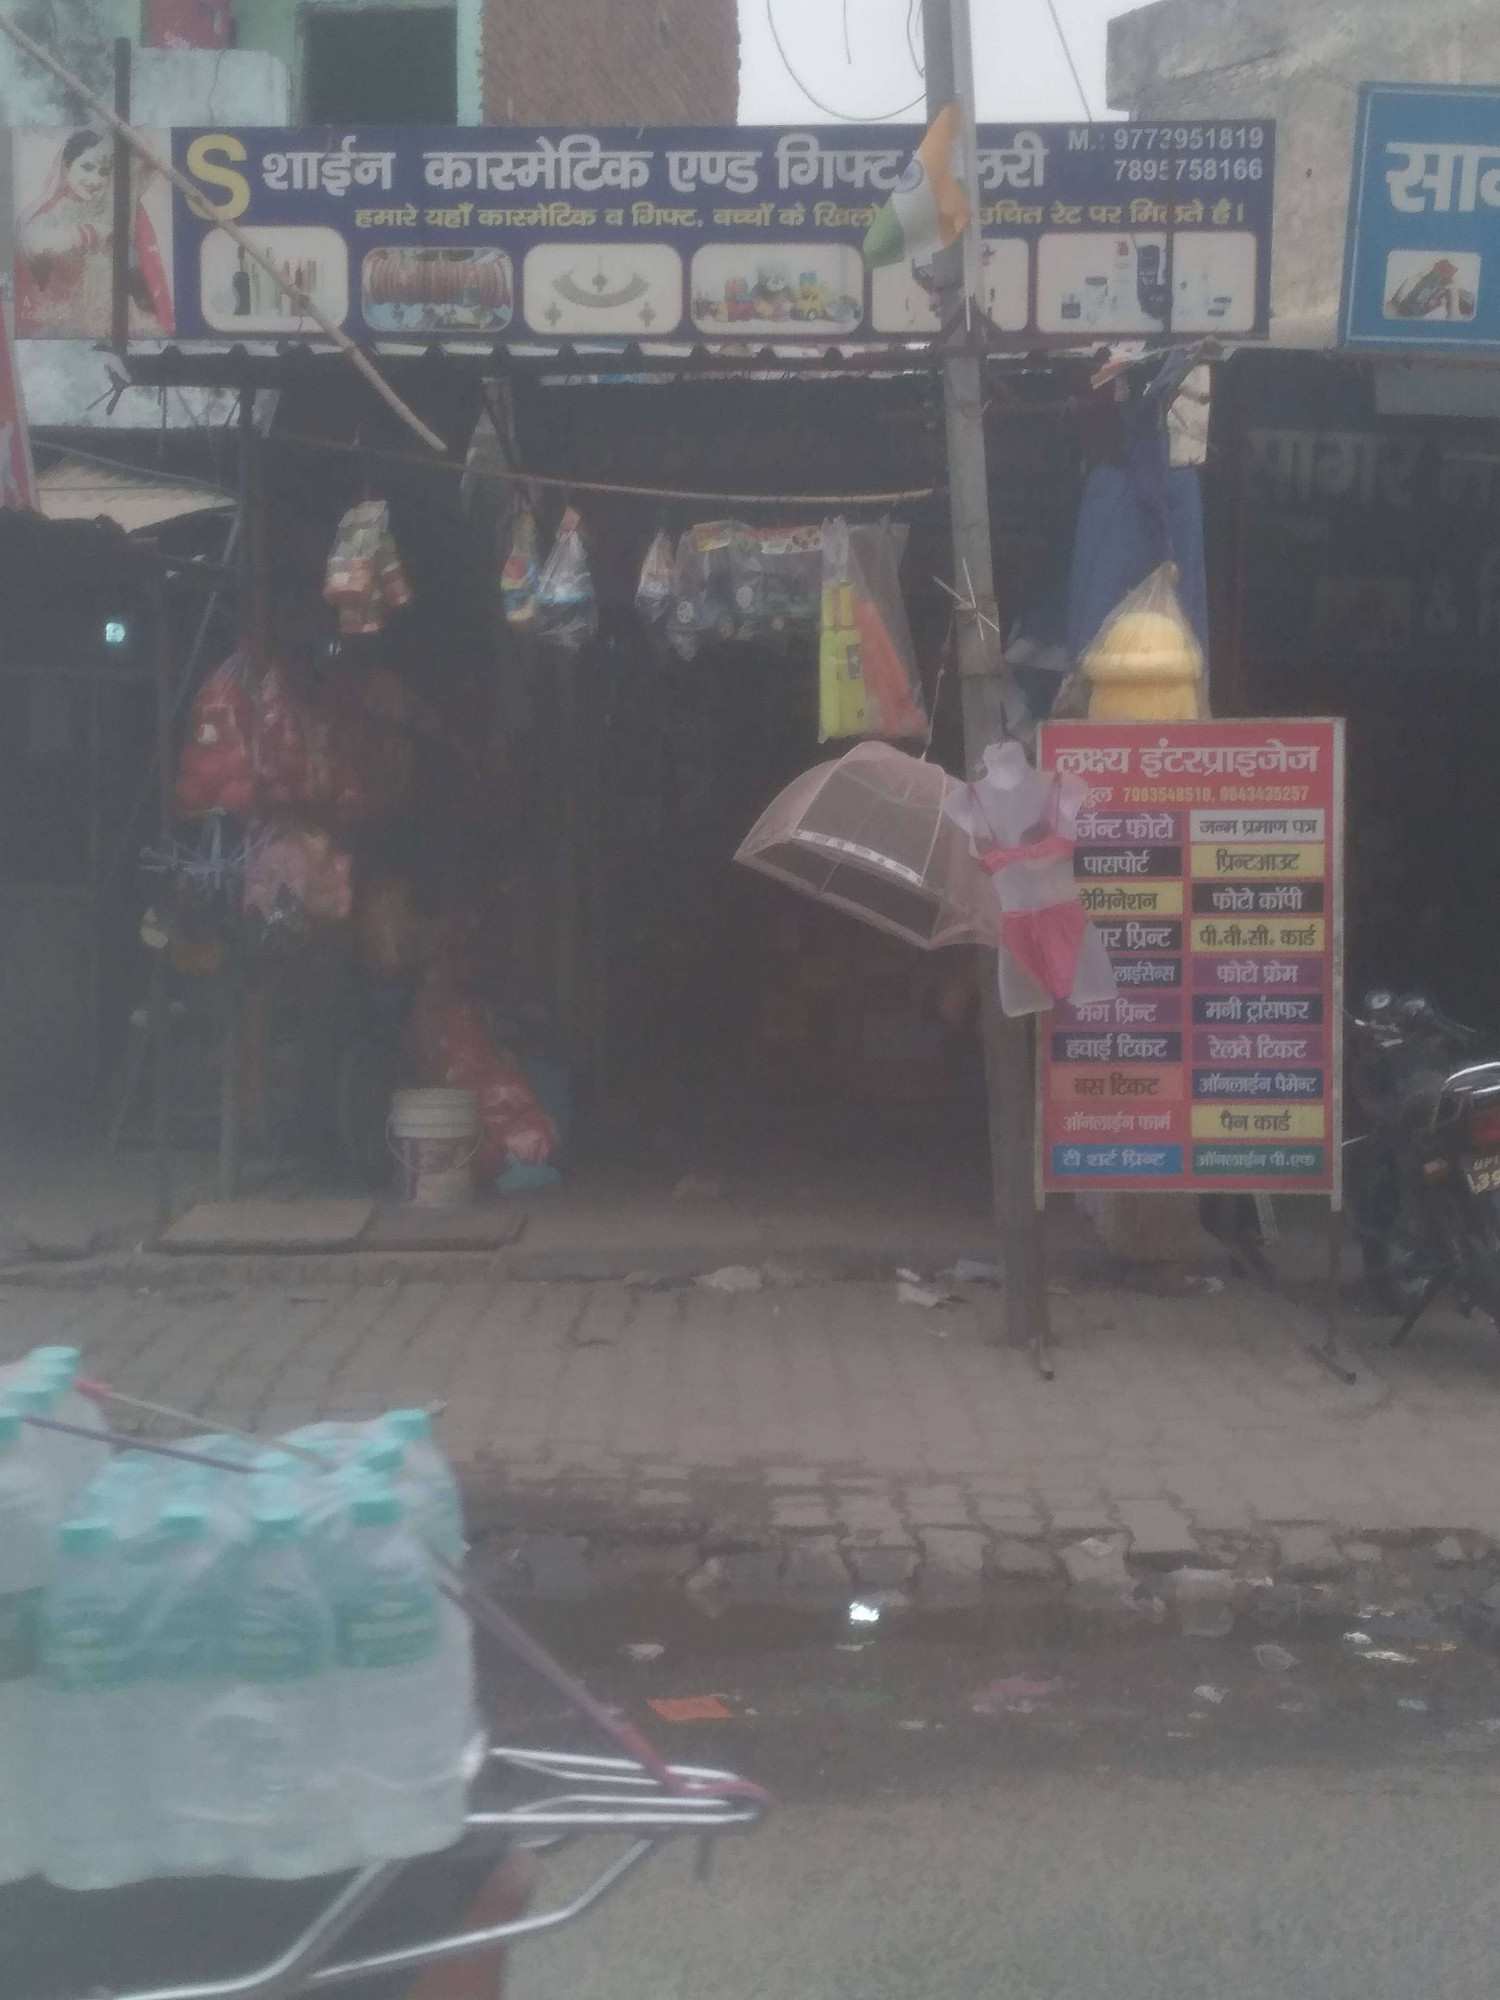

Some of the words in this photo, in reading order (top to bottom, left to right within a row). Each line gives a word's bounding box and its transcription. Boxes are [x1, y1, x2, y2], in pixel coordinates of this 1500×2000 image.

[1112, 126, 1264, 151] 9773951819
[186, 134, 251, 222] S
[262, 135, 396, 196] शाईन
[666, 148, 762, 194] एण्ड
[775, 132, 902, 191] गिफ्ट
[1113, 157, 1264, 182] 7895758166
[355, 202, 418, 228] हमारे
[604, 207, 624, 227] व
[778, 203, 807, 226] के
[1051, 199, 1083, 225] रेट
[1088, 205, 1122, 225] पर
[1056, 747, 1132, 775] लक्ष्य
[1126, 812, 1175, 839] फोटो
[1200, 818, 1238, 835] जन्म
[1242, 818, 1287, 836] प्रमाण
[1292, 818, 1317, 835] पत्र
[1083, 850, 1152, 873] पासपोर्ट
[1211, 887, 1255, 909] फोटो
[1258, 887, 1303, 910] कॉपी
[1125, 922, 1173, 950] प्रिन्ट
[1279, 923, 1317, 947] कार्ड
[1215, 961, 1259, 984] फोटो
[1205, 999, 1242, 1020] मनी
[1065, 1032, 1113, 1061] हवाई
[1117, 1032, 1168, 1059] टिकट
[1256, 1033, 1307, 1059] टिकट
[1108, 1071, 1161, 1097] टिकट
[1253, 1111, 1292, 1132] कार्ड
